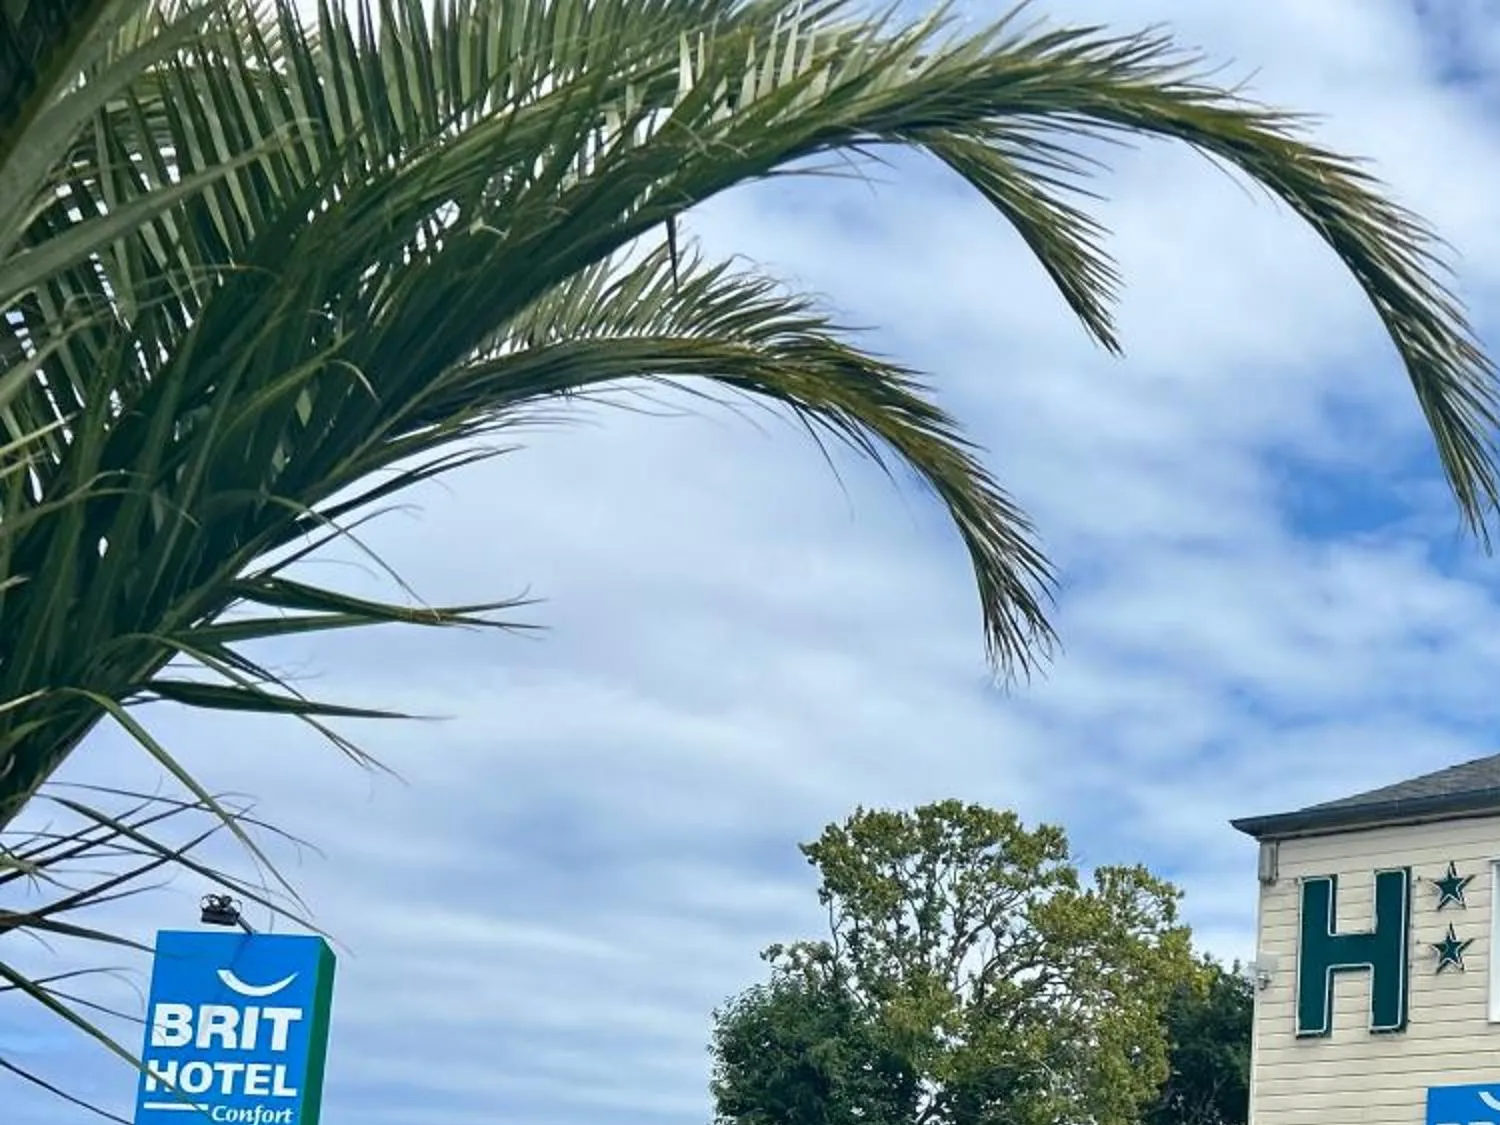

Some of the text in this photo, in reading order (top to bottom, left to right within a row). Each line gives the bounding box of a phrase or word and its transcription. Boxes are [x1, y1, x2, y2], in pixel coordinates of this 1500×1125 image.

[1296, 866, 1412, 1039] H
[150, 1002, 303, 1052] BRIT
[144, 1060, 297, 1097] HOTEL
